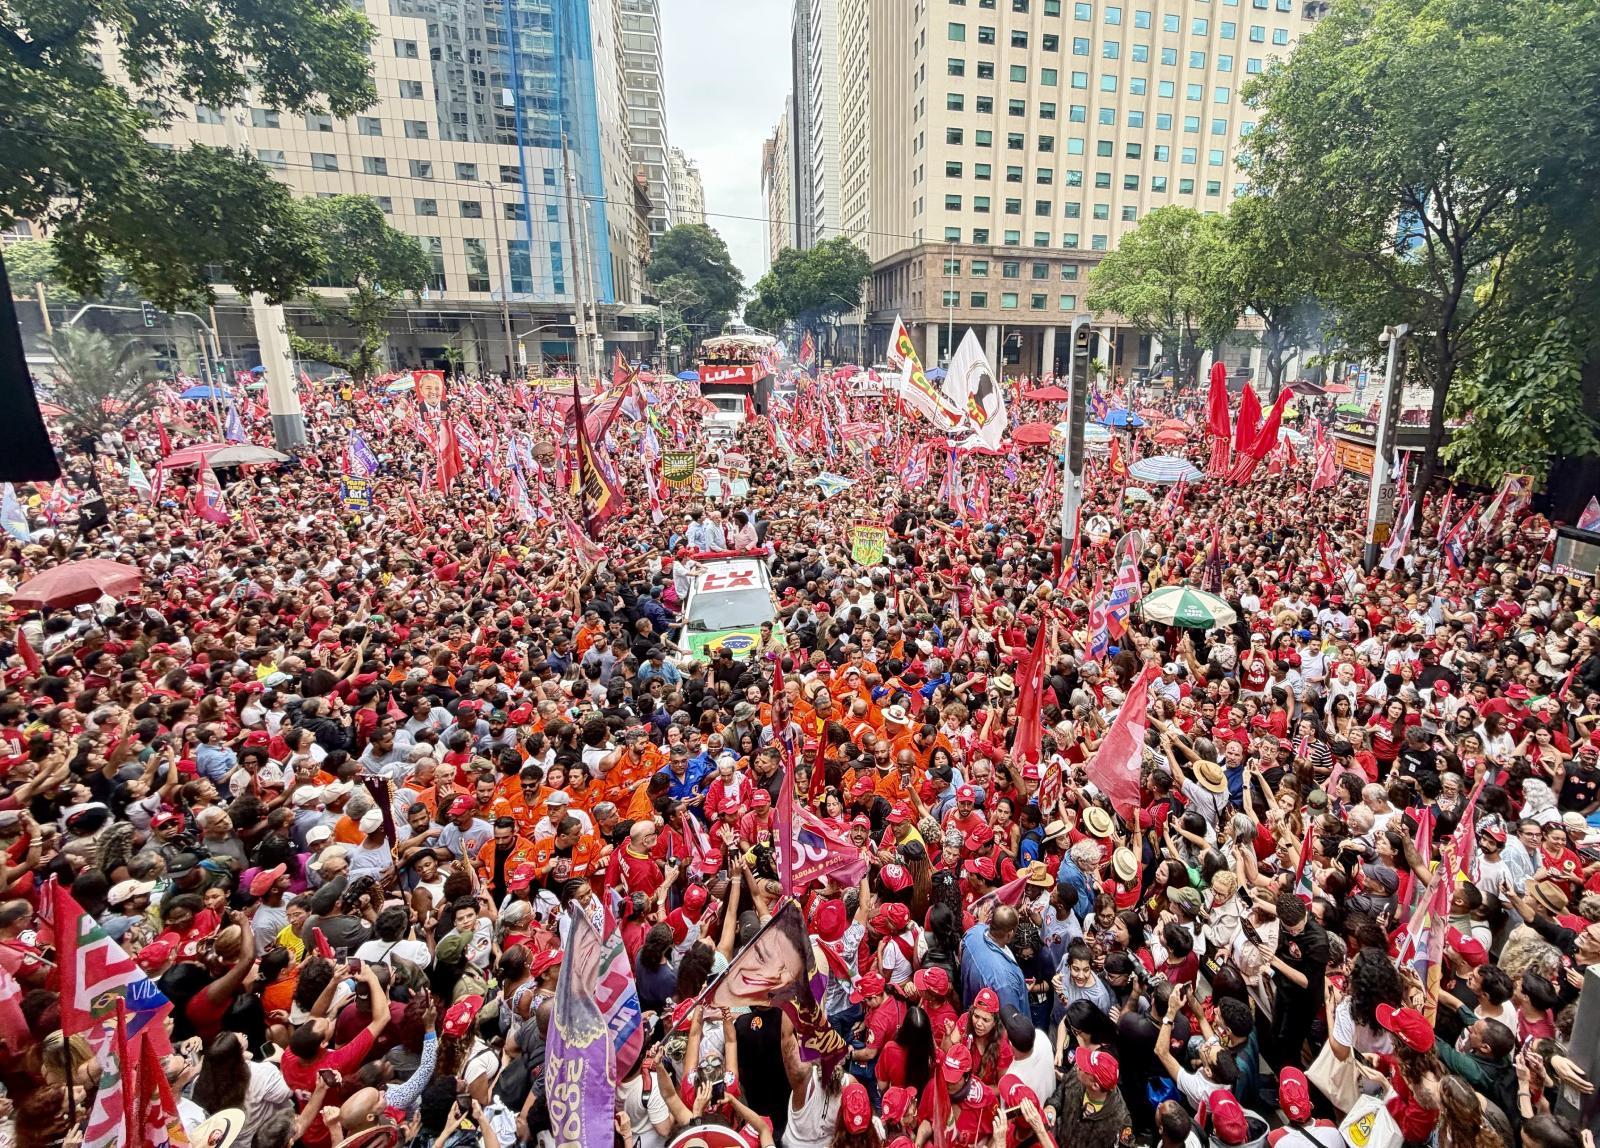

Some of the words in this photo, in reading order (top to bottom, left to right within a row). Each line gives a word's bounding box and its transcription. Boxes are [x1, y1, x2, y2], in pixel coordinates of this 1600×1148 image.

[705, 367, 746, 383] LULA
[1380, 488, 1394, 499] 30
[825, 855, 843, 868] PSOL
